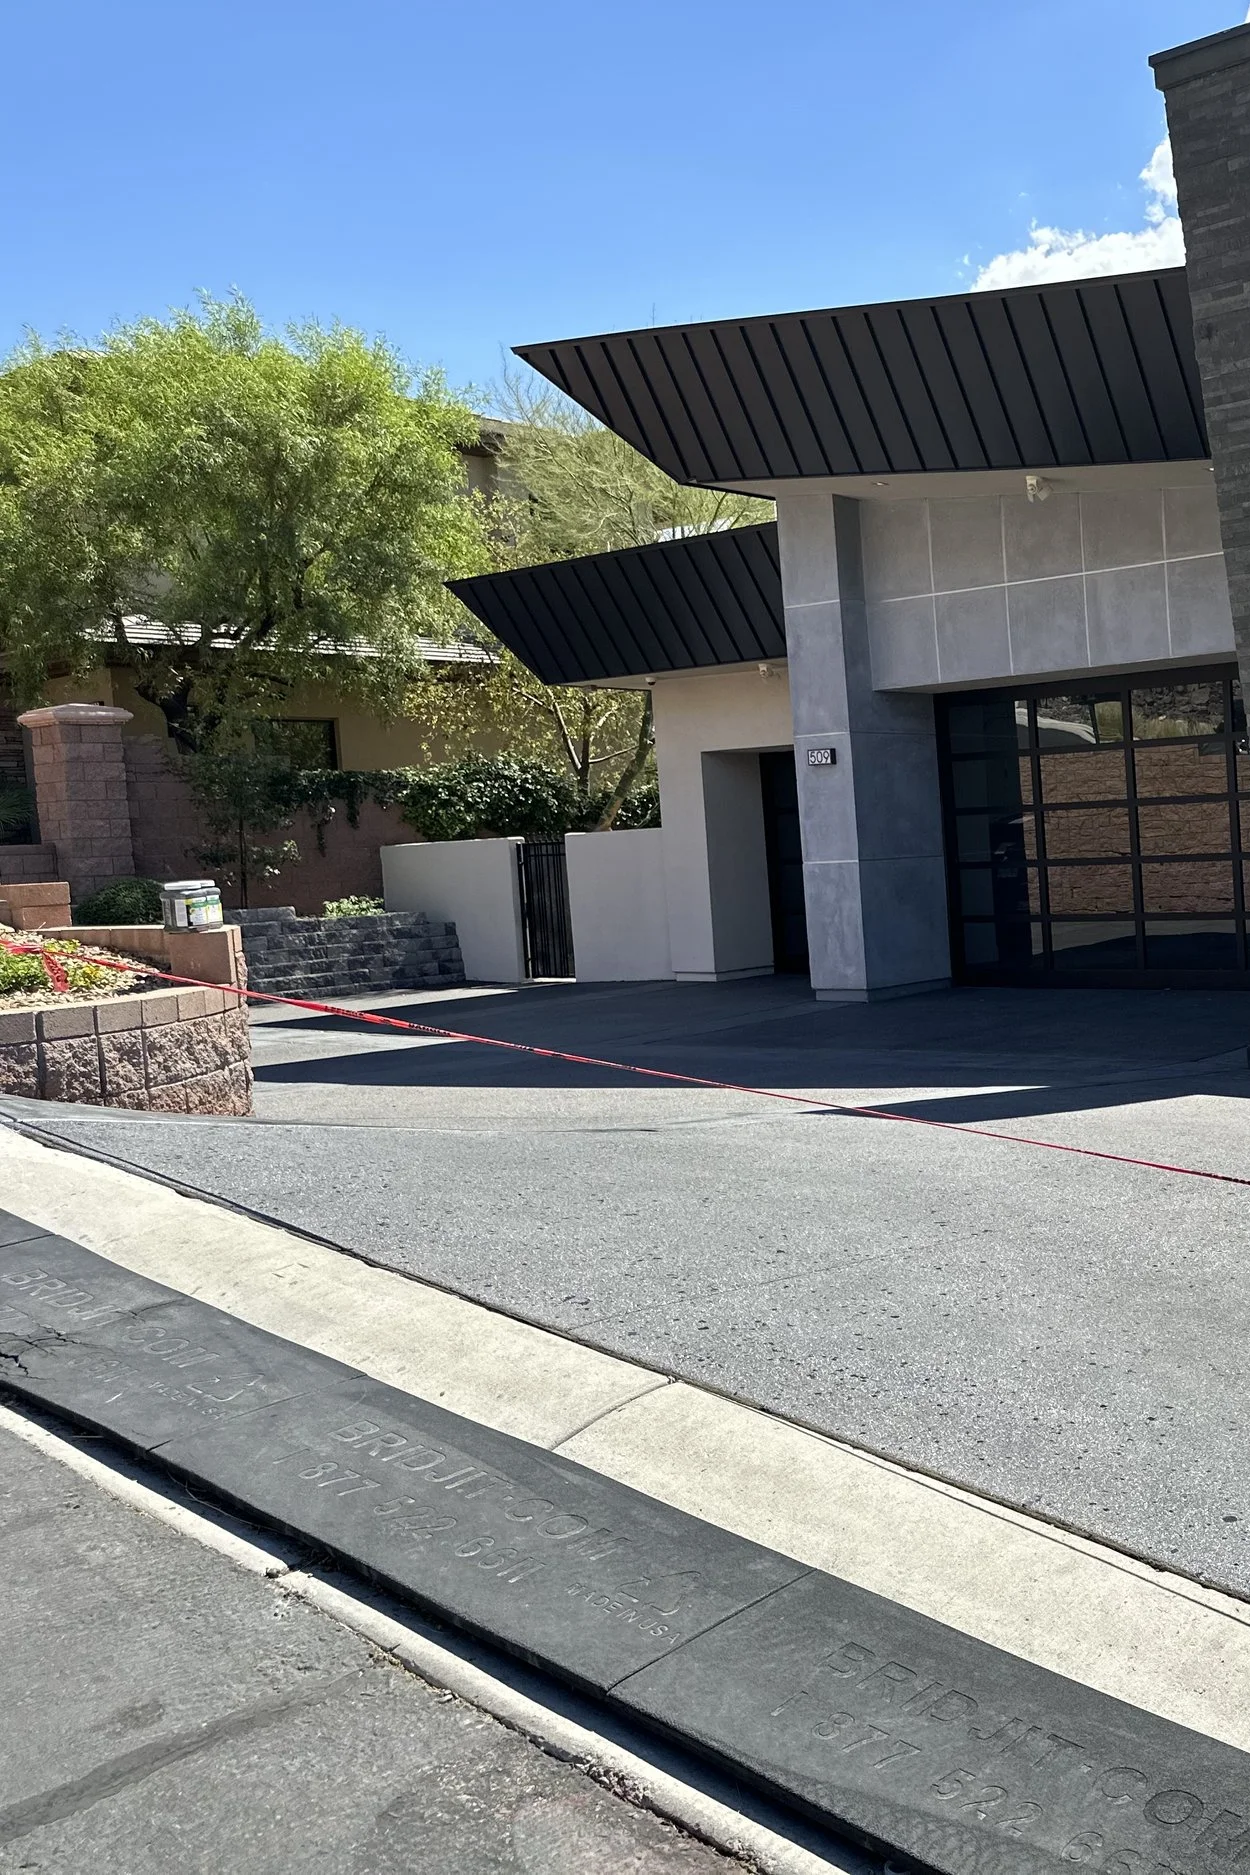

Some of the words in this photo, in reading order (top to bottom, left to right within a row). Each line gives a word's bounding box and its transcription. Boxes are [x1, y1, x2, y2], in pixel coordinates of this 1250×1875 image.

[810, 750, 830, 764] 509
[299, 1461, 381, 1496] 877
[373, 1495, 457, 1540] 522
[454, 1536, 547, 1583] 6611
[563, 1582, 623, 1614] MADE
[616, 1607, 645, 1625] IN
[637, 1621, 682, 1645] USA
[811, 1712, 922, 1768] 877
[931, 1768, 1044, 1836] 522
